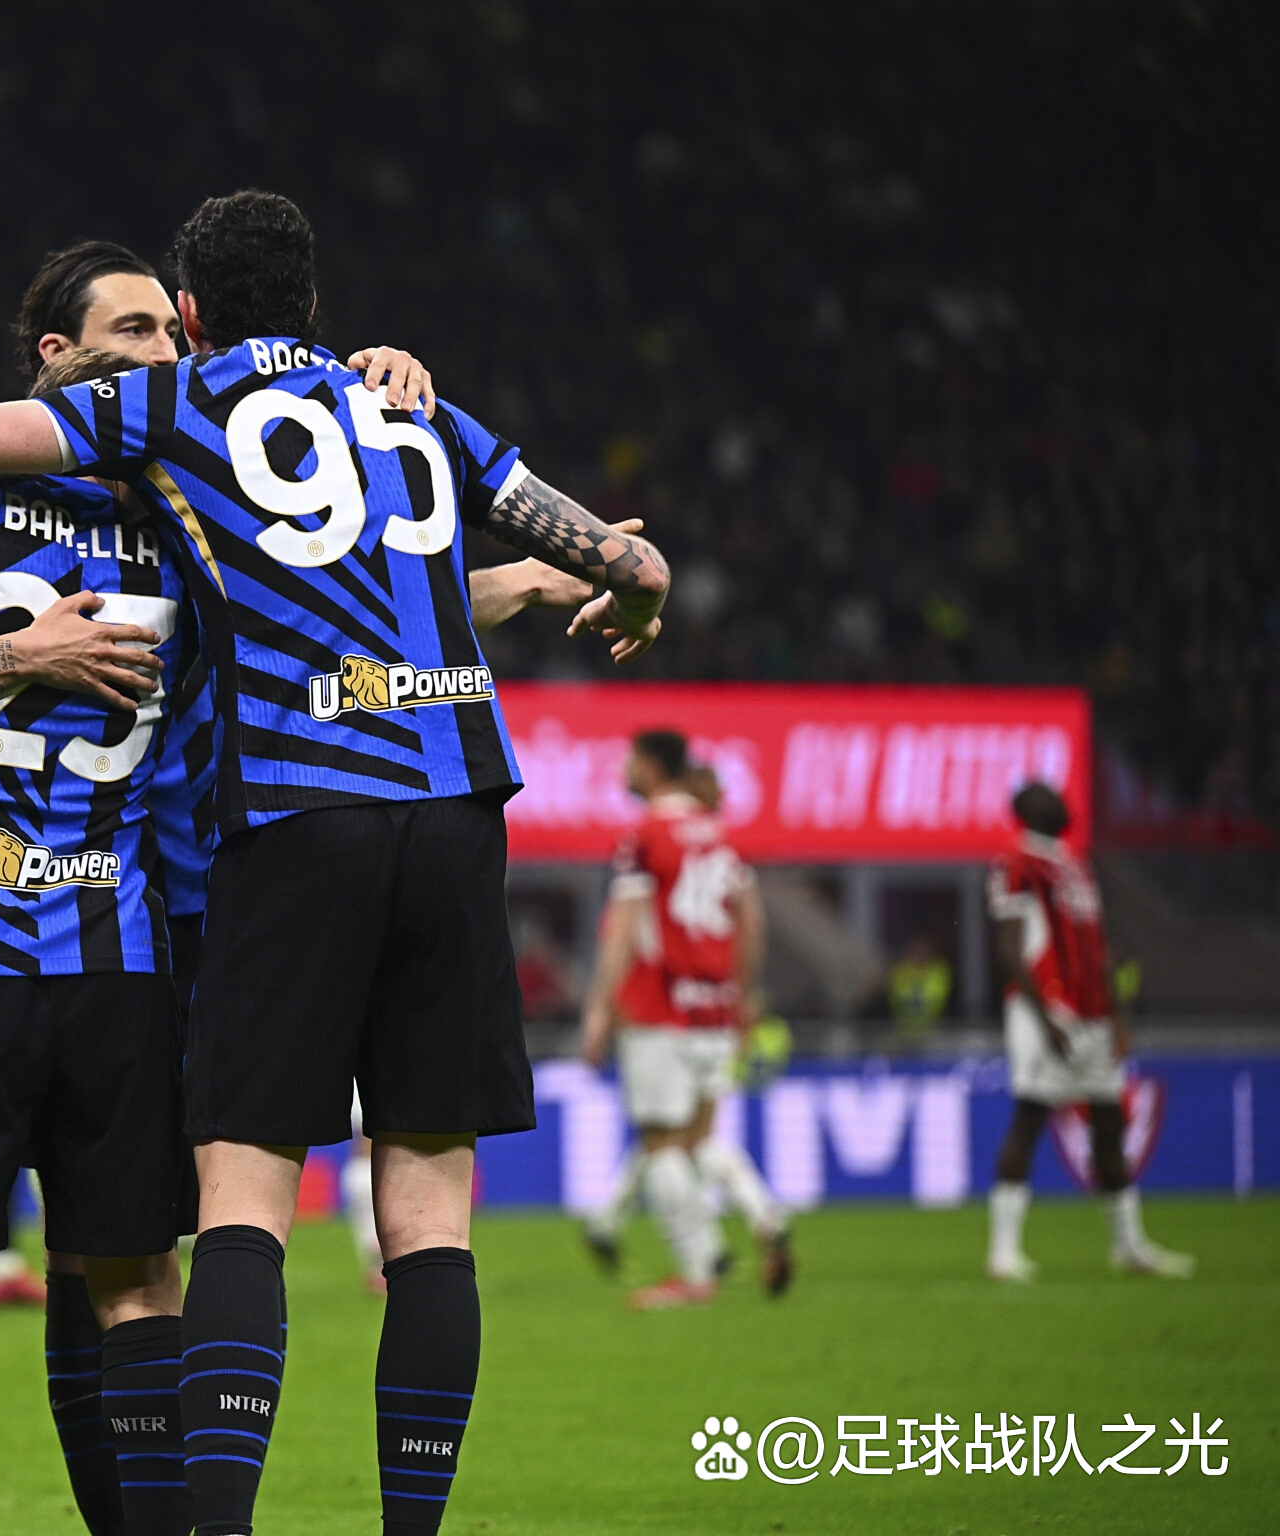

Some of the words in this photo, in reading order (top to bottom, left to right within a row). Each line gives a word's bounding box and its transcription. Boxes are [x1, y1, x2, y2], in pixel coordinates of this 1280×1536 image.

[226, 381, 457, 568] 95
[388, 663, 491, 709] Power
[17, 847, 119, 888] Power
[219, 1394, 271, 1417] INTER
[110, 1416, 168, 1434] INTER
[401, 1437, 454, 1457] INTER
